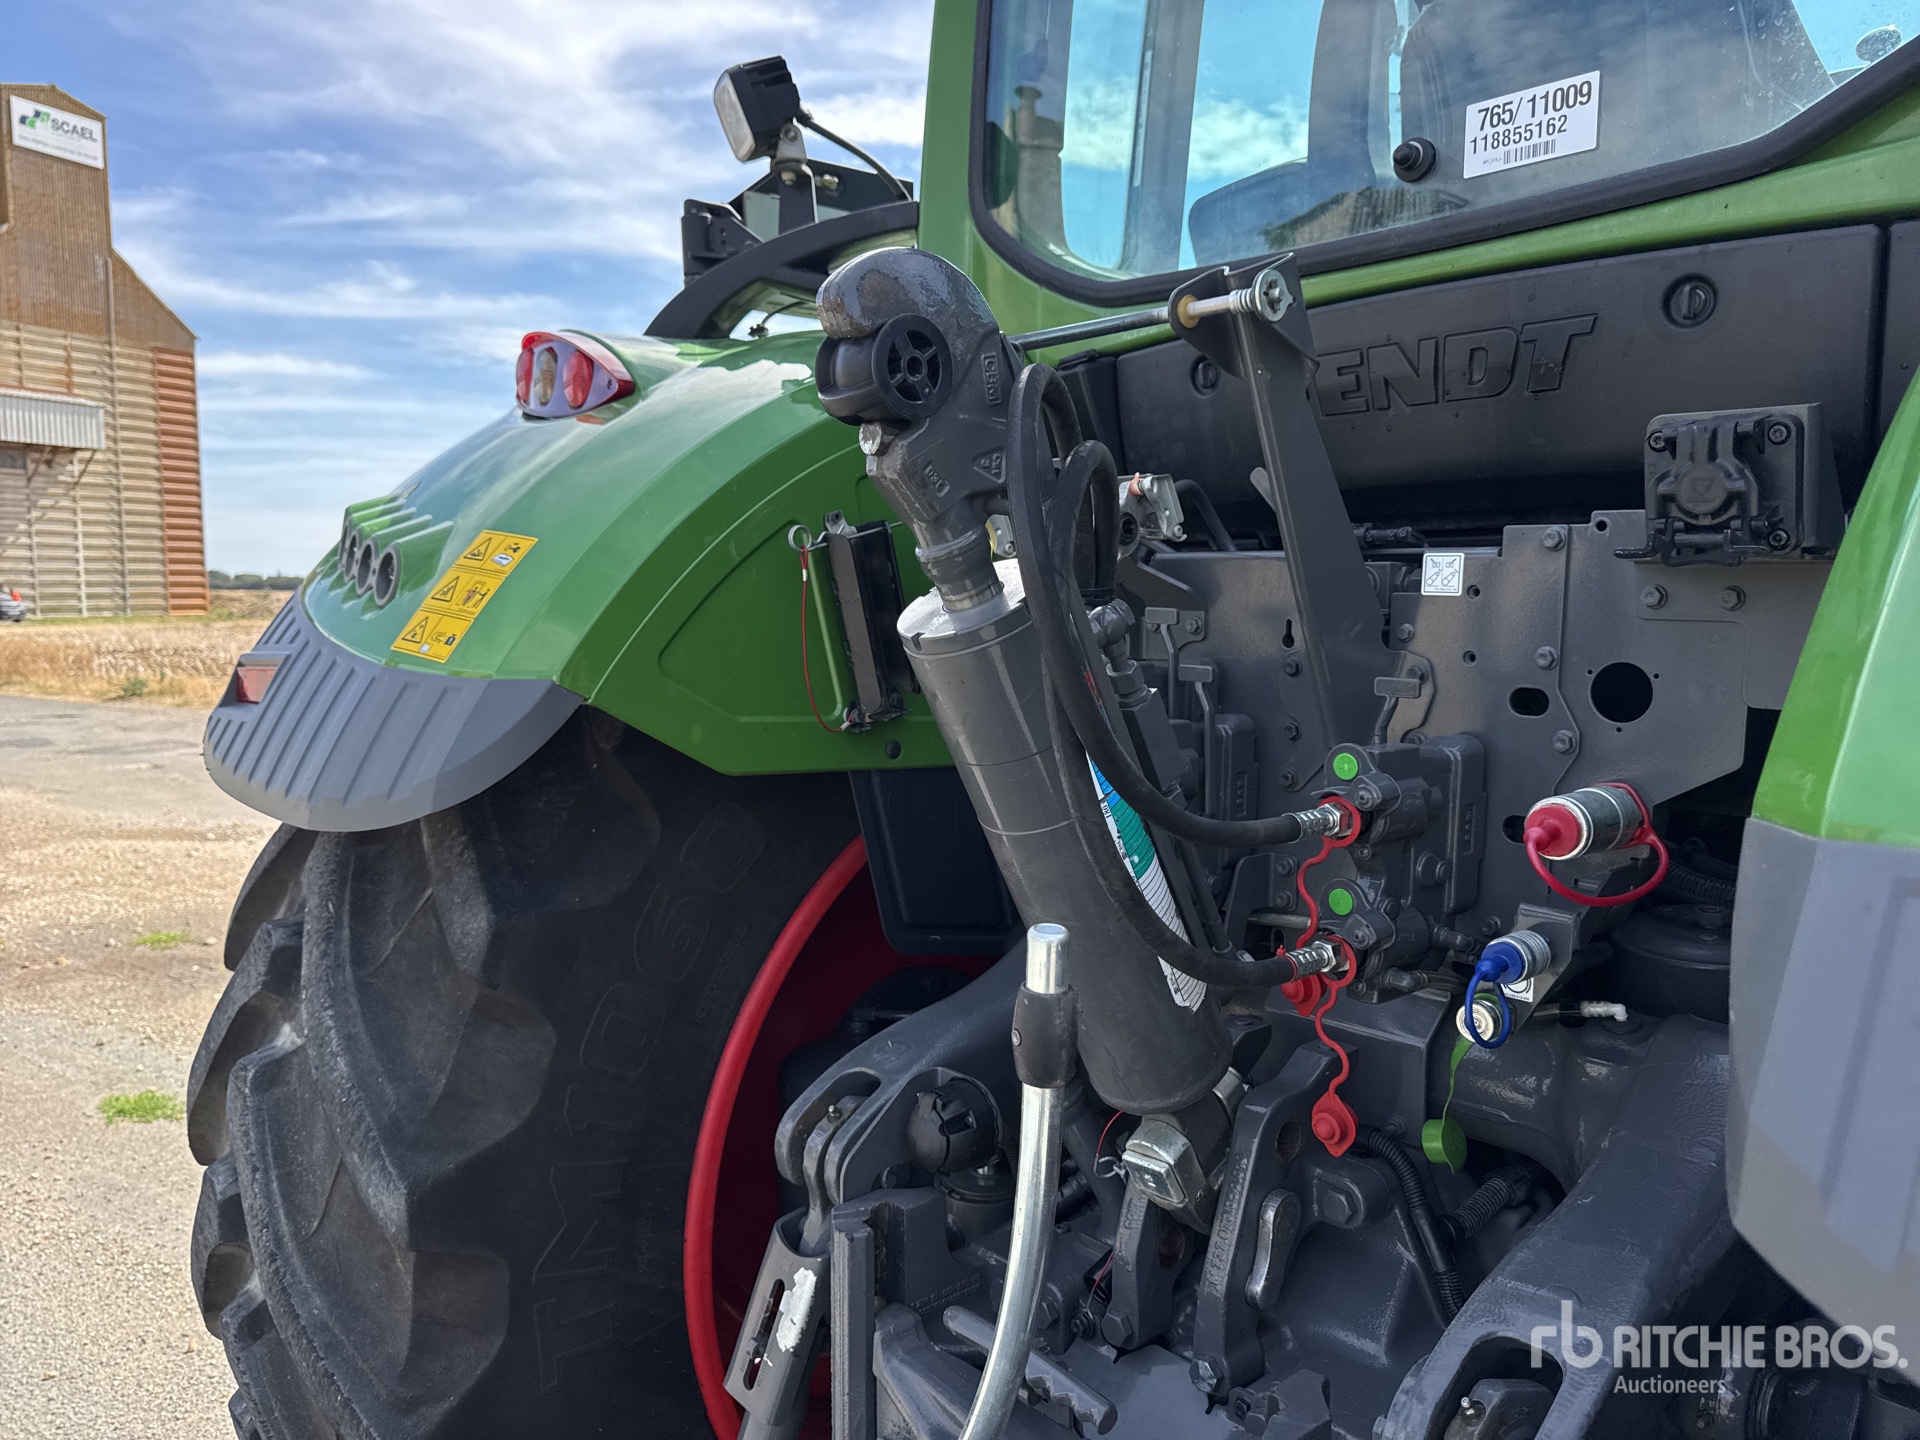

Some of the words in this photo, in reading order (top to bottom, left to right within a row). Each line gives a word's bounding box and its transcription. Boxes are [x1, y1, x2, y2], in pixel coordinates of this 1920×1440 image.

[51, 118, 98, 143] SCAEL
[1470, 114, 1568, 155] 118855162
[1315, 313, 1598, 417] ENDT
